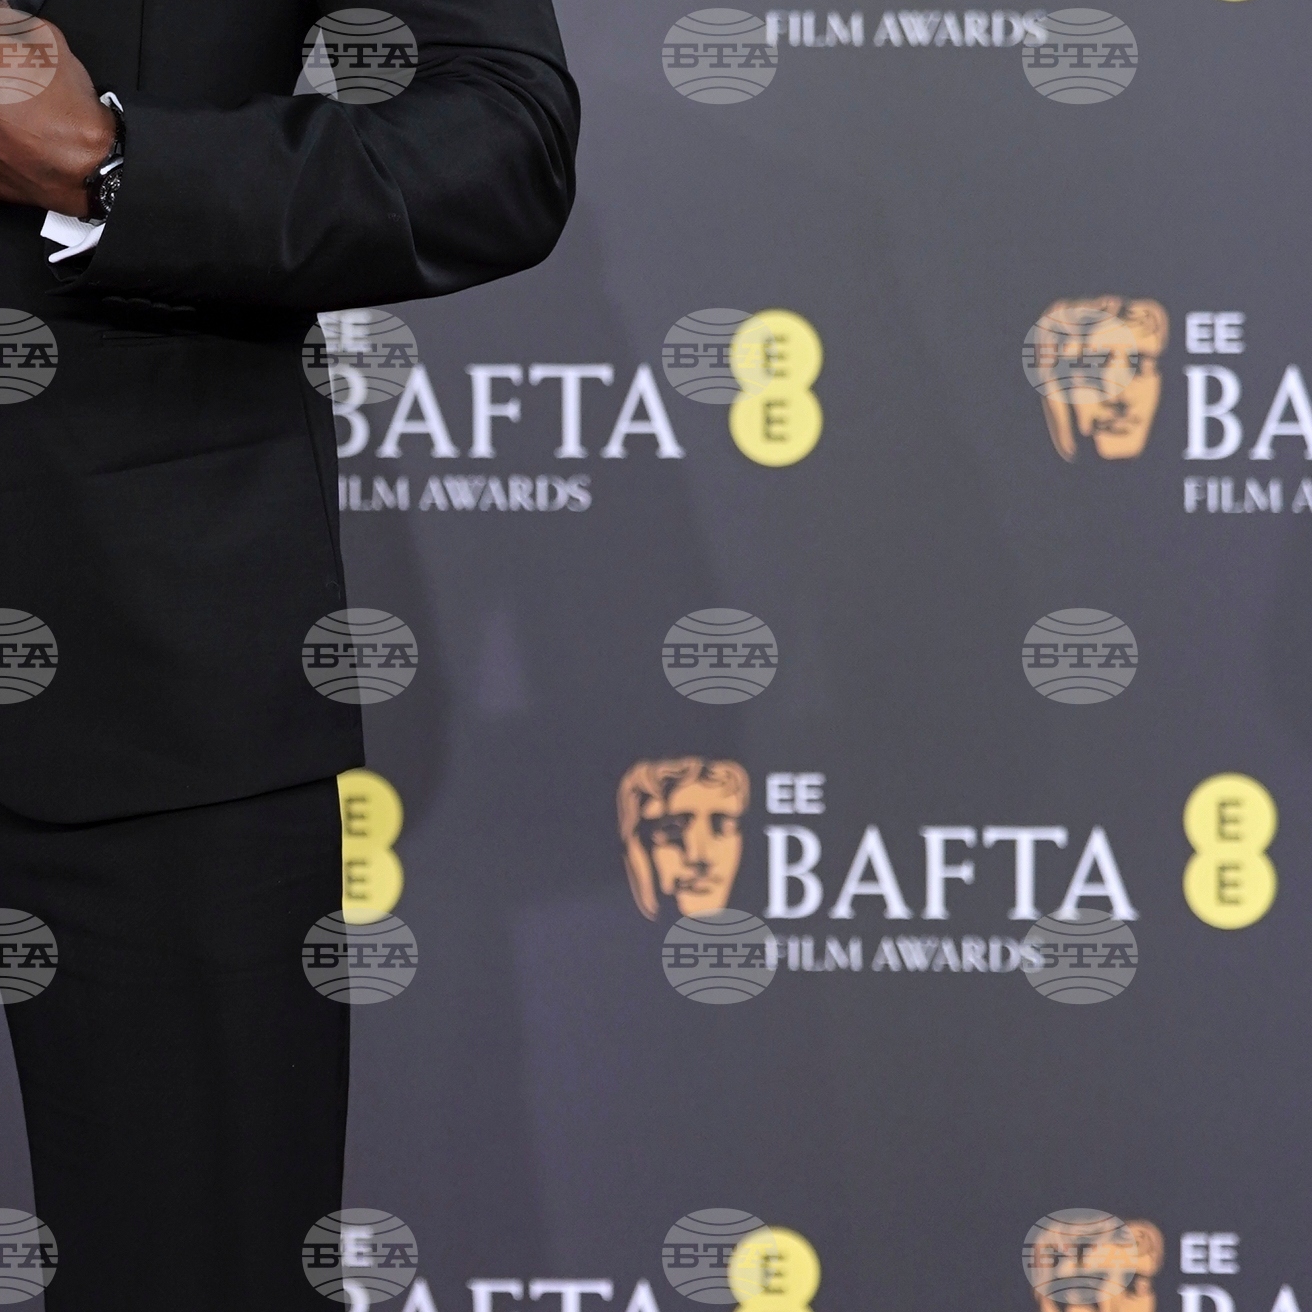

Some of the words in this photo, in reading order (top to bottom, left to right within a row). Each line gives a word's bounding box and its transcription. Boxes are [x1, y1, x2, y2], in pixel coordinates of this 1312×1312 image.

[766, 11, 863, 47] FILM
[874, 11, 1048, 47] AWARDS
[1186, 312, 1244, 353] EE
[339, 475, 410, 511] ILM
[420, 475, 591, 511] AWARDS
[1184, 477, 1282, 513] FILM
[766, 773, 824, 814] EE
[766, 826, 1137, 921] BAFTA
[765, 938, 862, 973] FILM
[873, 938, 1044, 973] AWARDS
[1181, 1233, 1238, 1274] EE
